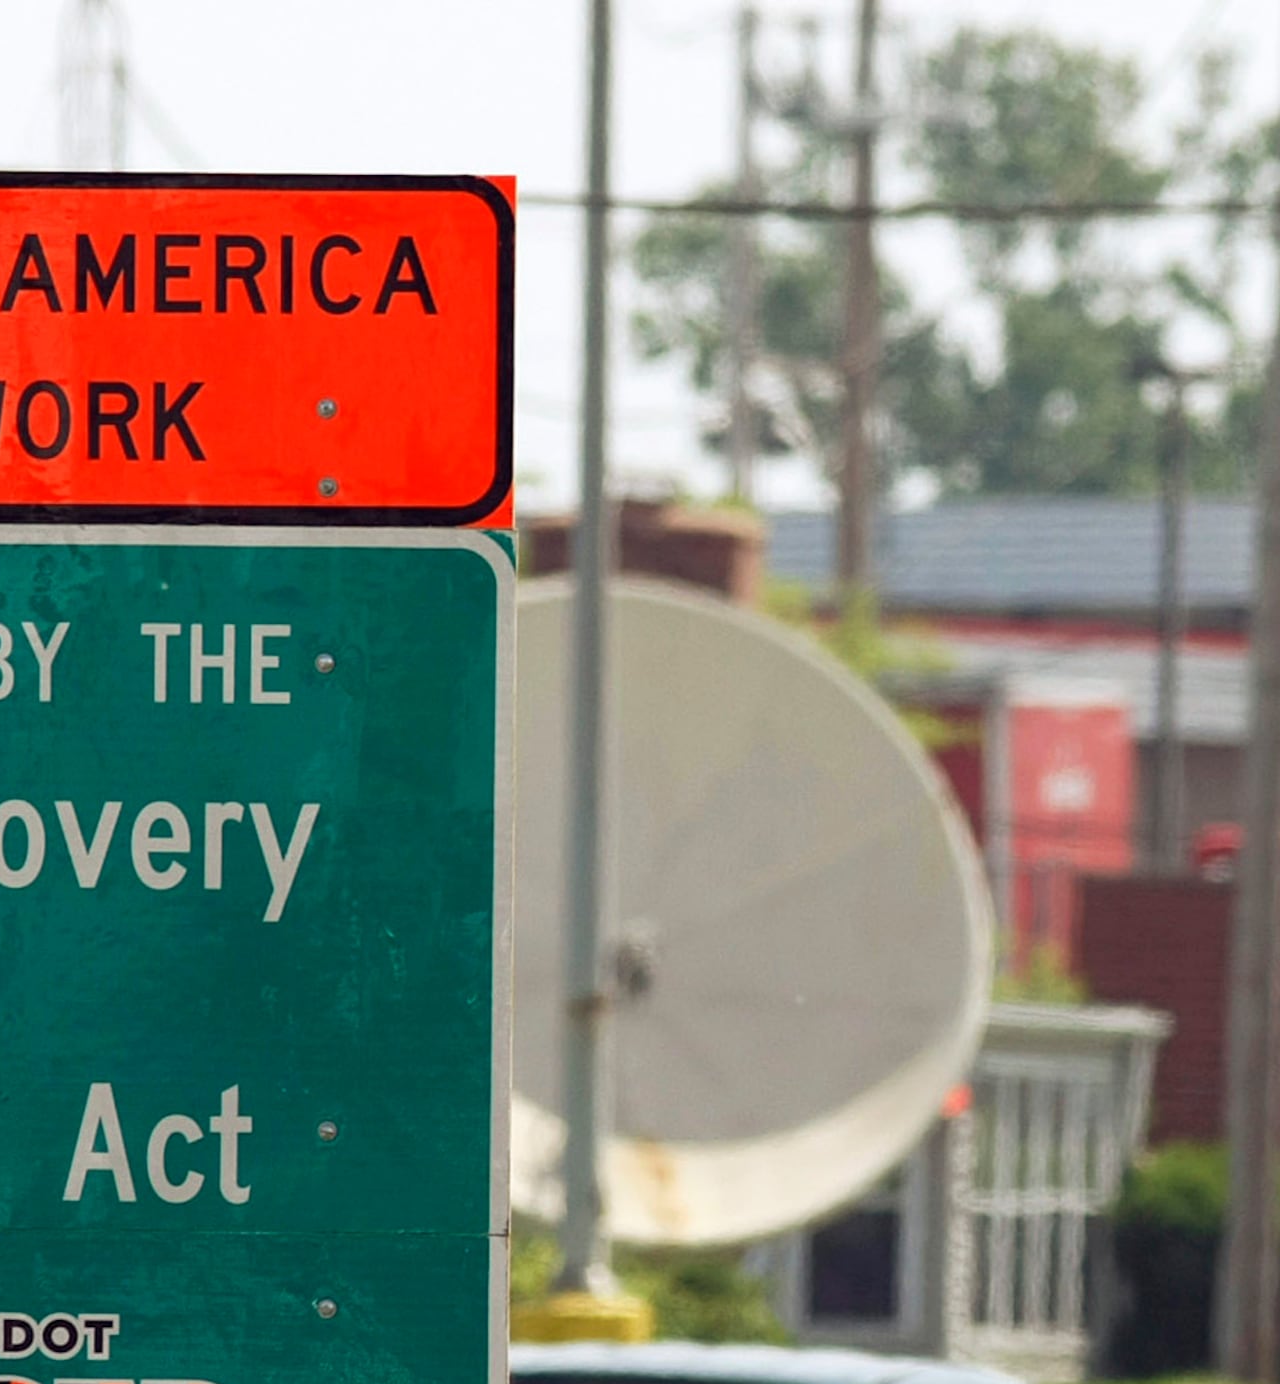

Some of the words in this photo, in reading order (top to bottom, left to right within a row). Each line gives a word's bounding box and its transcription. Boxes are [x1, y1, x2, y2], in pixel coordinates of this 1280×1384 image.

[0, 234, 438, 315] AMERICA
[141, 623, 291, 704] THE
[63, 1083, 253, 1205] Act
